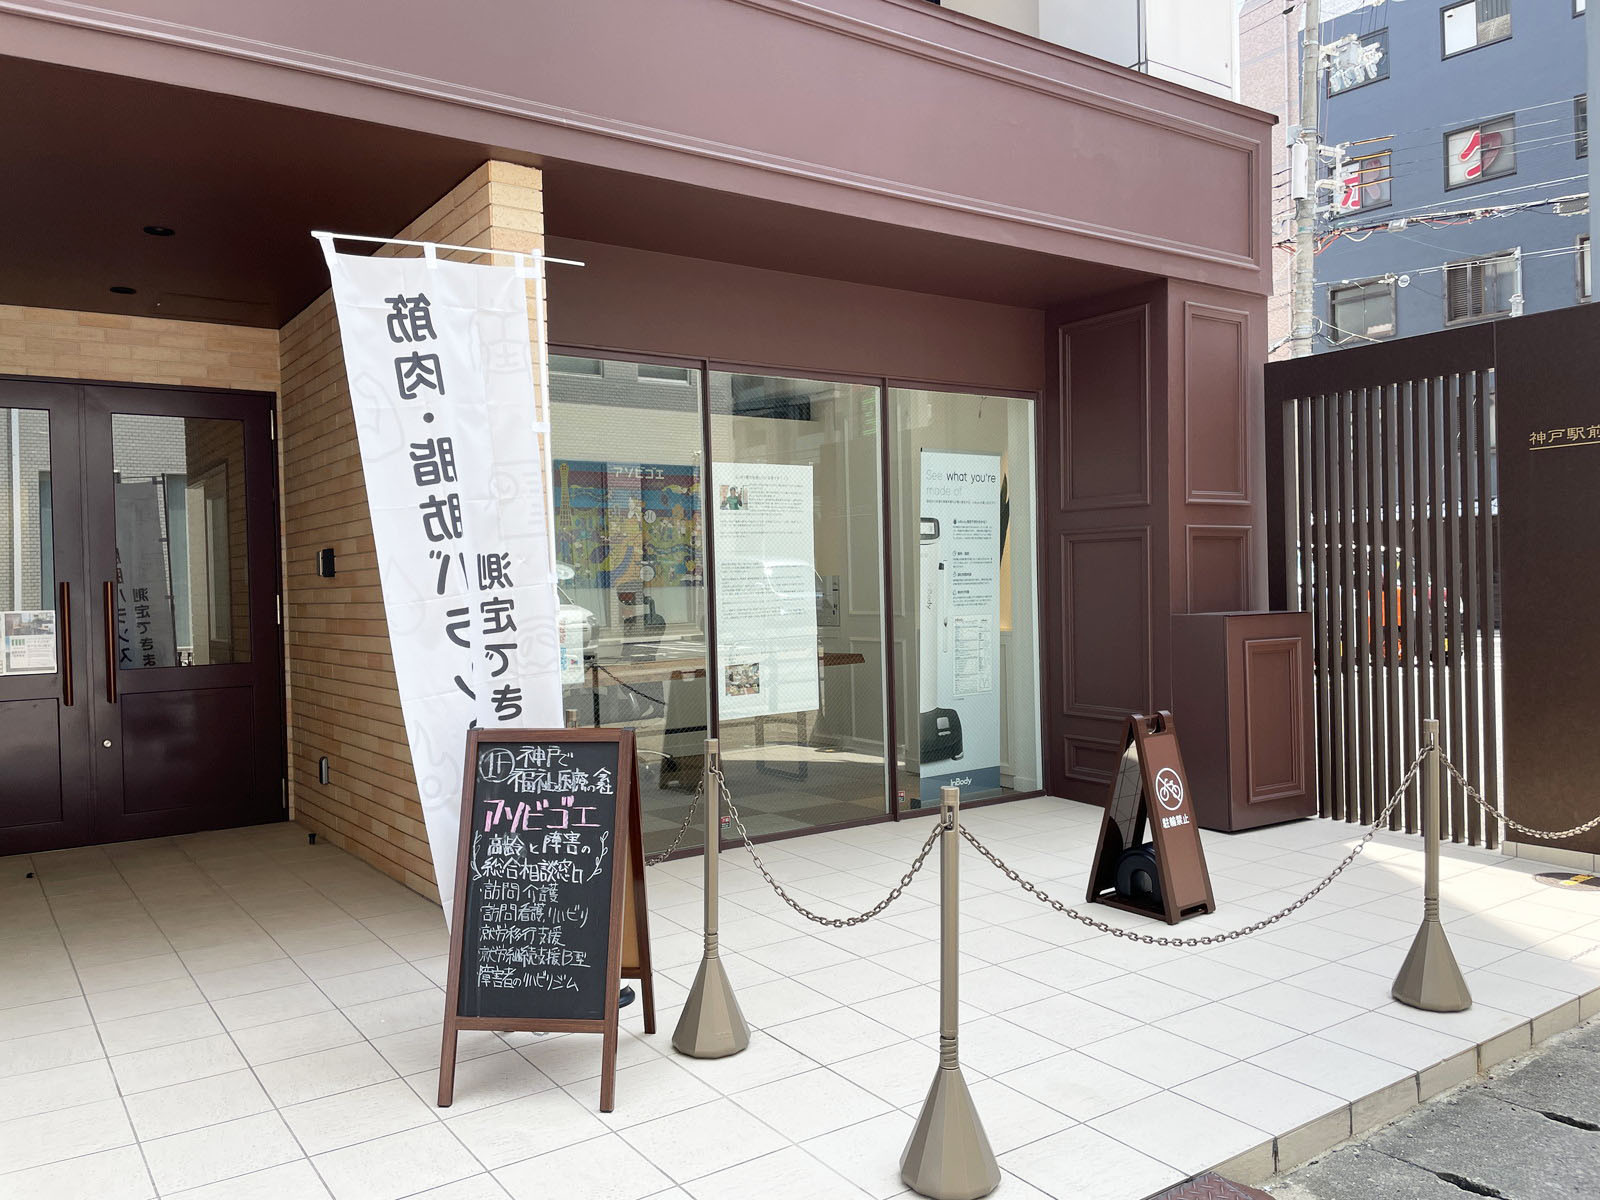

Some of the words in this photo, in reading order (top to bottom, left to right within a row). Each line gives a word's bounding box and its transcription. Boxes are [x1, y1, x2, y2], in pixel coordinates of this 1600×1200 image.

[1529, 425, 1600, 445] 神戸駅前
[946, 472, 967, 482] what
[971, 473, 996, 484] you're
[516, 746, 574, 768] 神戸で
[484, 796, 601, 833] アソビゴエ
[487, 831, 591, 856] 高齢と障害の
[481, 856, 583, 884] 総合相談窓口
